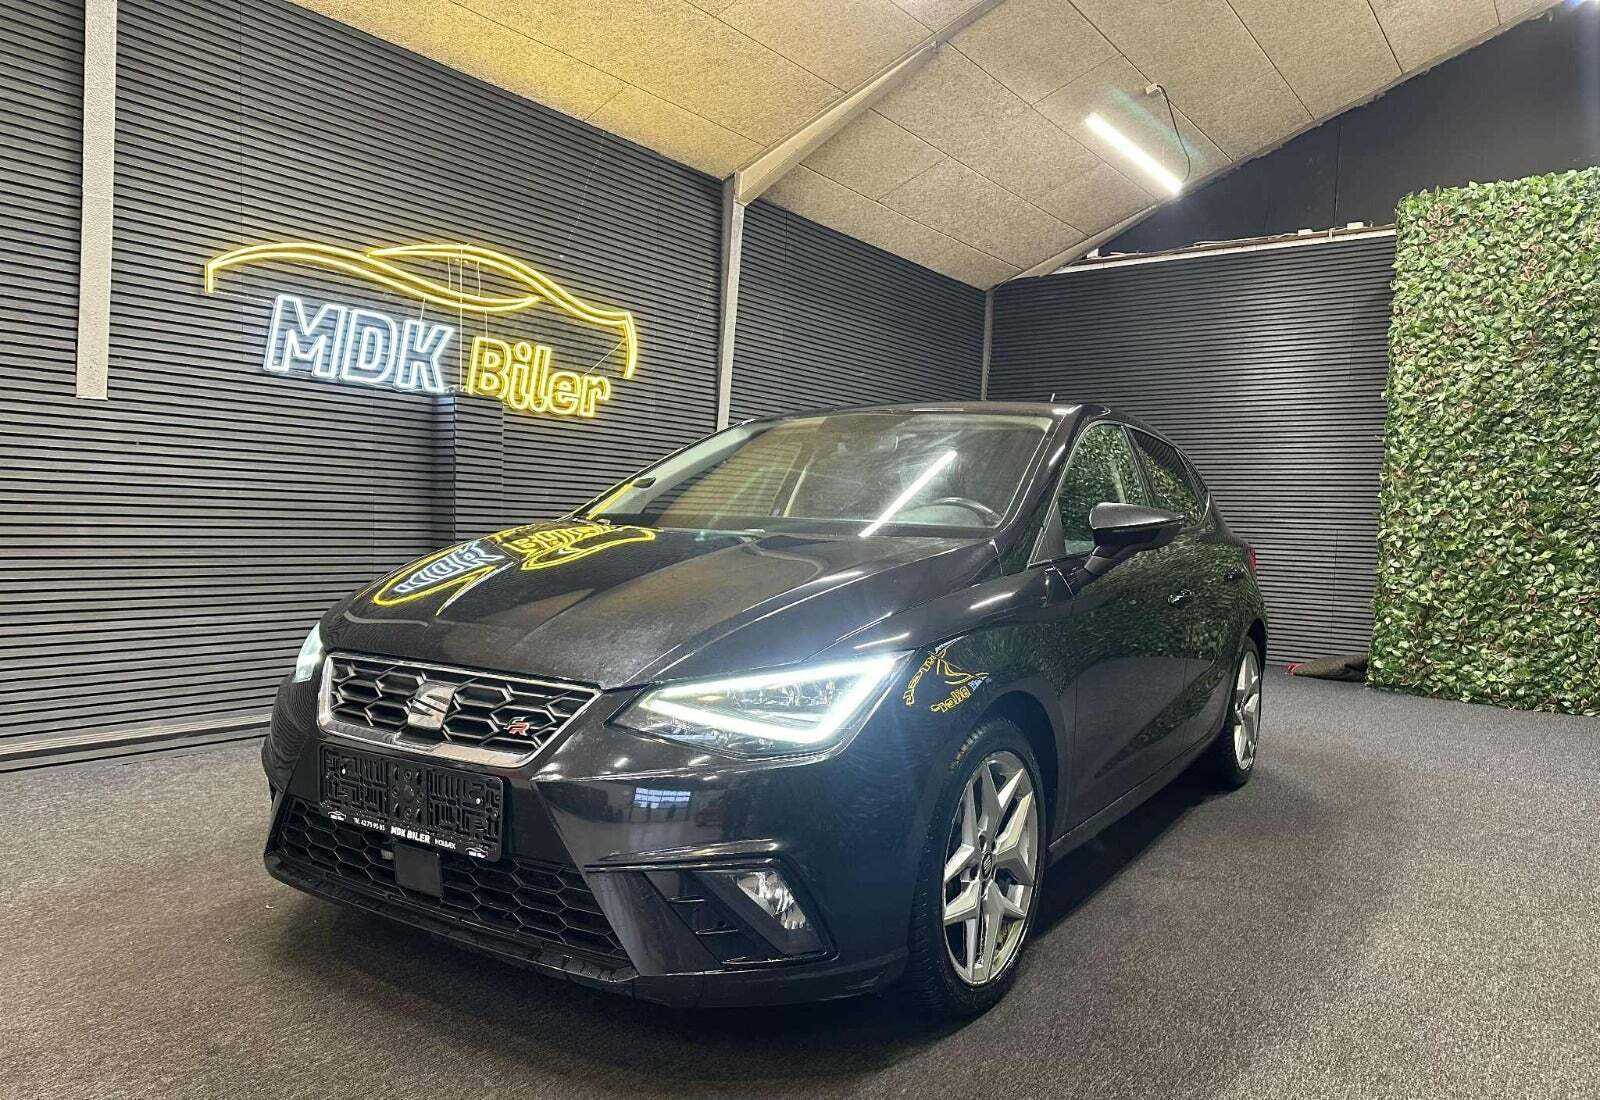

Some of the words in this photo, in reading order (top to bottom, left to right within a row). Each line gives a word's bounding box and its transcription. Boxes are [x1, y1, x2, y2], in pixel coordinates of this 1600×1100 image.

[264, 294, 454, 393] MDK
[466, 335, 611, 417] Biler
[390, 825, 406, 838] MDK
[406, 830, 431, 845] BILER
